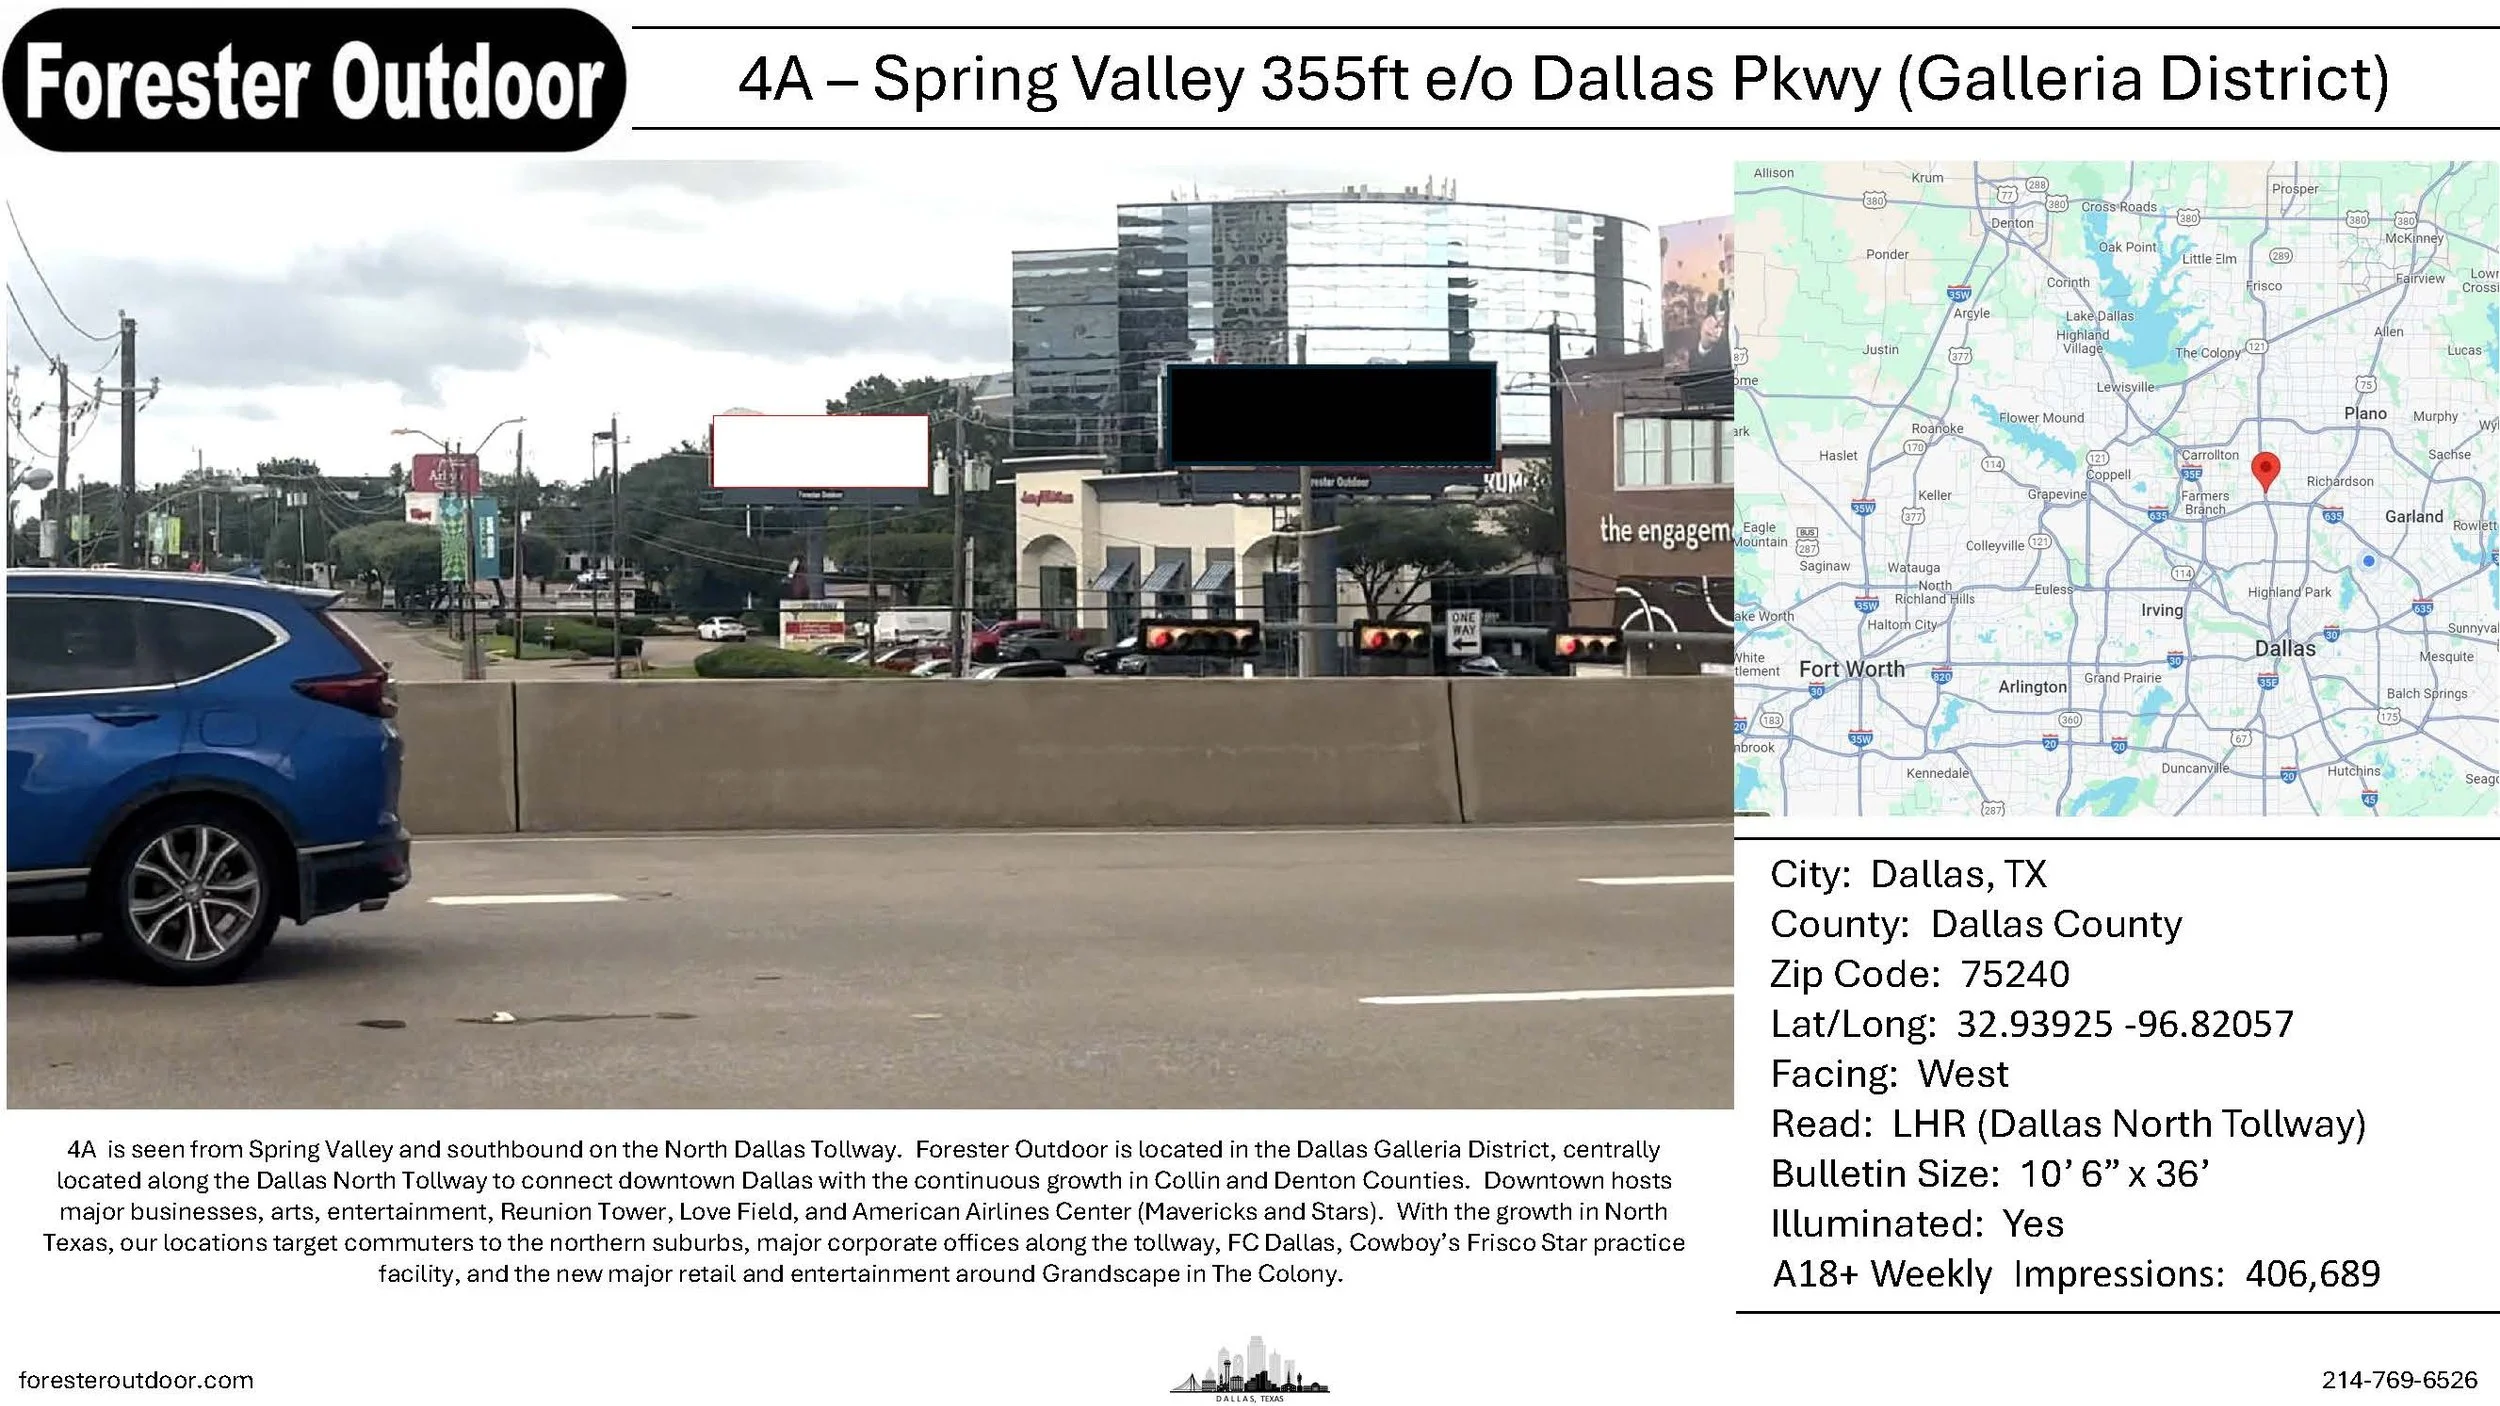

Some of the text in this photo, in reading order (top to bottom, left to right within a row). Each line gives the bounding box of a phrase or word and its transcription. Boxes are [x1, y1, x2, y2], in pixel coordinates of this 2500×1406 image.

[1754, 168, 1794, 179] Allison
[1912, 173, 1944, 184] Krum
[2272, 184, 2319, 195] Prosper
[1866, 196, 1884, 206] 380
[2081, 201, 2157, 213] Cross Roads
[1991, 218, 2034, 229] Denton
[2385, 233, 2444, 246] McKinney
[2099, 242, 2156, 253] Oak Point
[1866, 250, 1909, 261] Ponder
[2183, 253, 2237, 265] Little Elm
[2273, 251, 2290, 261] 289
[2047, 277, 2090, 288] Corinth
[2396, 273, 2445, 284] Fairview
[2246, 280, 2282, 291] Frisco
[2066, 311, 2134, 322] Lake Dallas
[2056, 330, 2109, 341] Highland
[2374, 326, 2404, 337] Allen
[1863, 344, 1899, 355] Justin
[2063, 343, 2103, 355] Village
[2176, 348, 2241, 361] The Colony
[2448, 345, 2481, 356] Lucas
[2097, 382, 2155, 393] Lewisville
[2000, 412, 2084, 424] Flower Mound
[2345, 407, 2387, 419] Plano
[2413, 411, 2458, 424] Murphy
[1912, 424, 1964, 435] Roanoke
[1819, 451, 1857, 462] Haslet
[2182, 450, 2239, 460] Carrollton
[2428, 449, 2471, 460] Sachse
[2086, 469, 2131, 482] Coppell
[2307, 476, 2374, 487] Richardson
[1919, 490, 1952, 500] Keller
[2028, 489, 2087, 502] Grapevine
[2182, 490, 2229, 502] Farmers
[2185, 504, 2226, 515] Branch
[2149, 511, 2168, 521] 635
[2385, 510, 2444, 523] Garland
[1743, 522, 1776, 534] Eagle
[2453, 520, 2497, 531] Rowlett
[1600, 513, 1734, 550] the engagem
[1966, 540, 2025, 553] Colleyville
[1800, 561, 1850, 574] Saginaw
[1888, 563, 1940, 575] Watauga
[1919, 581, 1952, 591] North
[2035, 585, 2073, 595] Euless
[1895, 594, 1975, 604] Richland Hills
[2248, 587, 2331, 600] Highland Park
[2142, 604, 2183, 619] Irving
[1452, 612, 1476, 623] ONE
[1452, 625, 1476, 636] WAY
[1868, 620, 1937, 632] Haltom City
[2255, 641, 2316, 656] Dallas
[2420, 652, 2474, 664] Mesquite
[1800, 661, 1905, 677] Fort Worth
[2084, 673, 2161, 684] Grand Prairie
[1999, 681, 2067, 696] Arlington
[2387, 688, 2467, 702] Balch Springs
[1907, 769, 1969, 779] Kennedale
[2162, 763, 2230, 774] Duncanville
[2328, 766, 2380, 777] Hutchins
